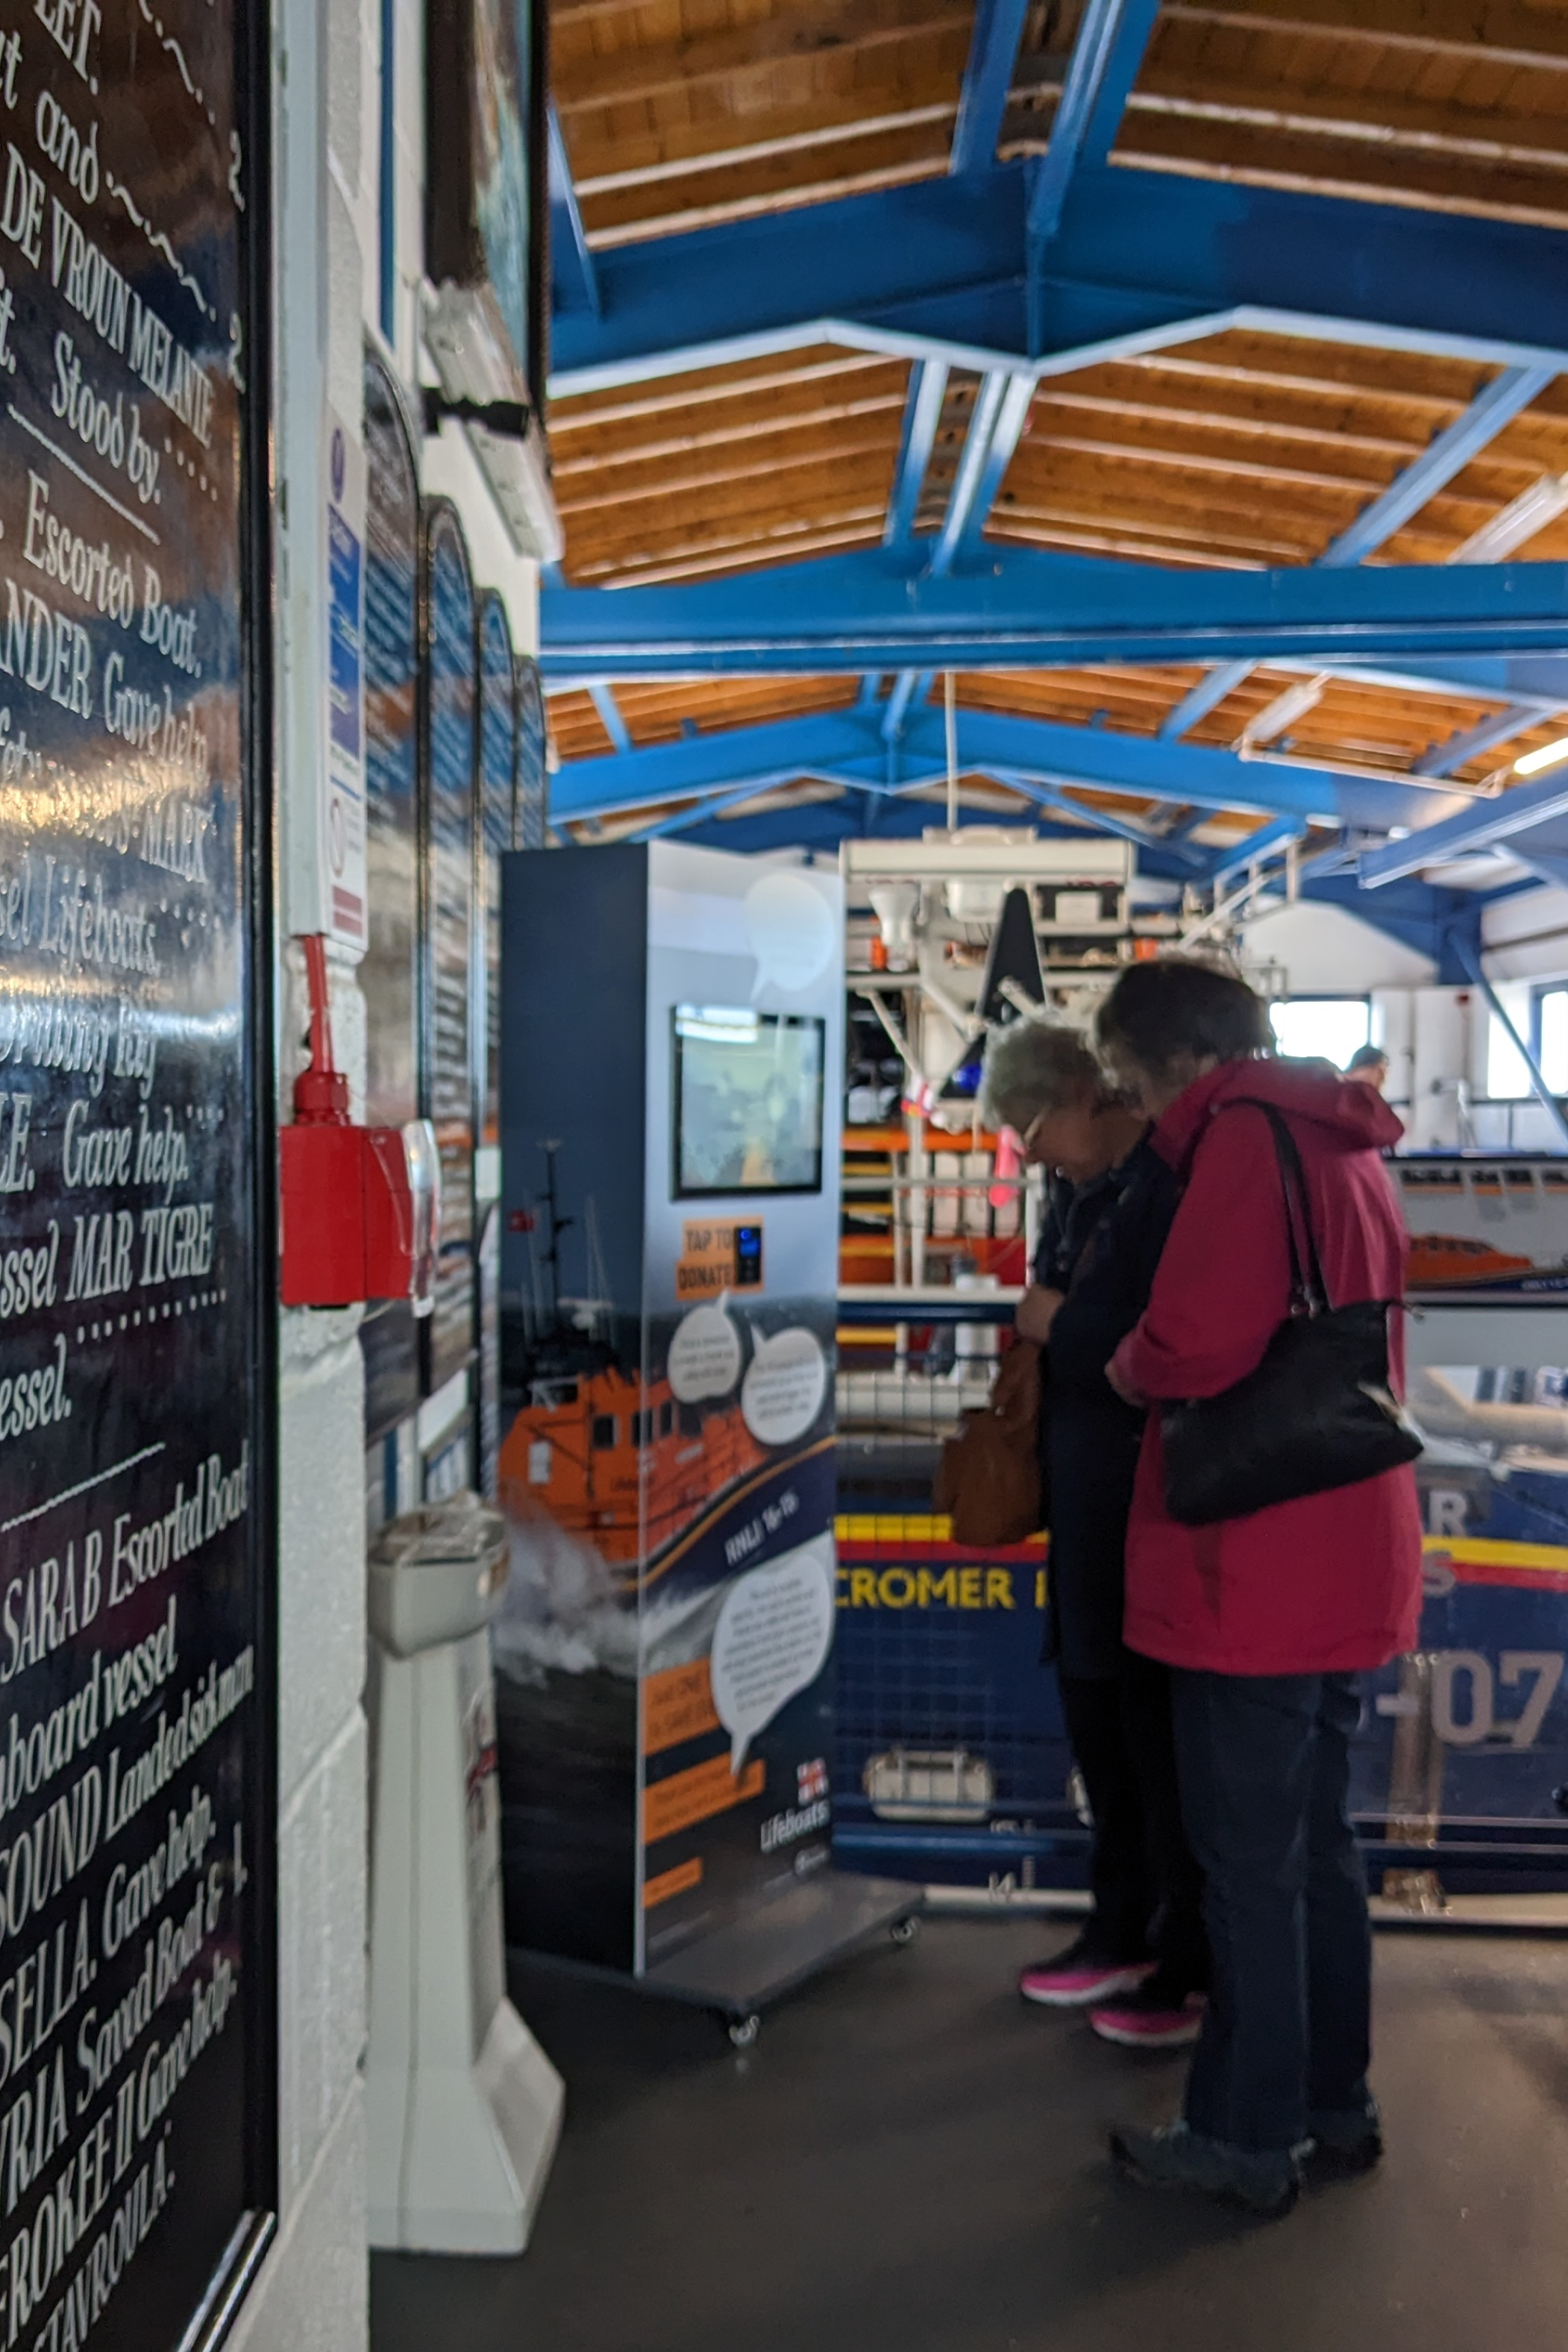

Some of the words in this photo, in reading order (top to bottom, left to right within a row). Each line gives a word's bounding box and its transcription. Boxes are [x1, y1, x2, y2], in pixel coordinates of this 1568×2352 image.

[35, 88, 99, 205] and
[1, 142, 46, 270] DE
[128, 290, 214, 449] MELANIE
[51, 330, 124, 469] Stood
[128, 404, 162, 506] by.
[23, 469, 135, 630] Escorted
[139, 564, 201, 679] Boat.
[0, 577, 92, 720] NDER
[63, 1100, 132, 1188] Gave
[134, 1104, 189, 1204] help.
[0, 1219, 60, 1314] ssel
[65, 1208, 134, 1302] MAR
[139, 1202, 214, 1287] TIGRE
[107, 1463, 204, 1608] Escorted
[104, 1593, 178, 1729] vessel
[0, 1765, 102, 1945] OUND
[105, 1689, 191, 1842] Landed
[761, 1799, 832, 1852] Lifeboats
[103, 1843, 166, 1960] Gave
[0, 2044, 69, 2219] RIA
[75, 1939, 154, 2116] Saved
[137, 2019, 192, 2141] Gave
